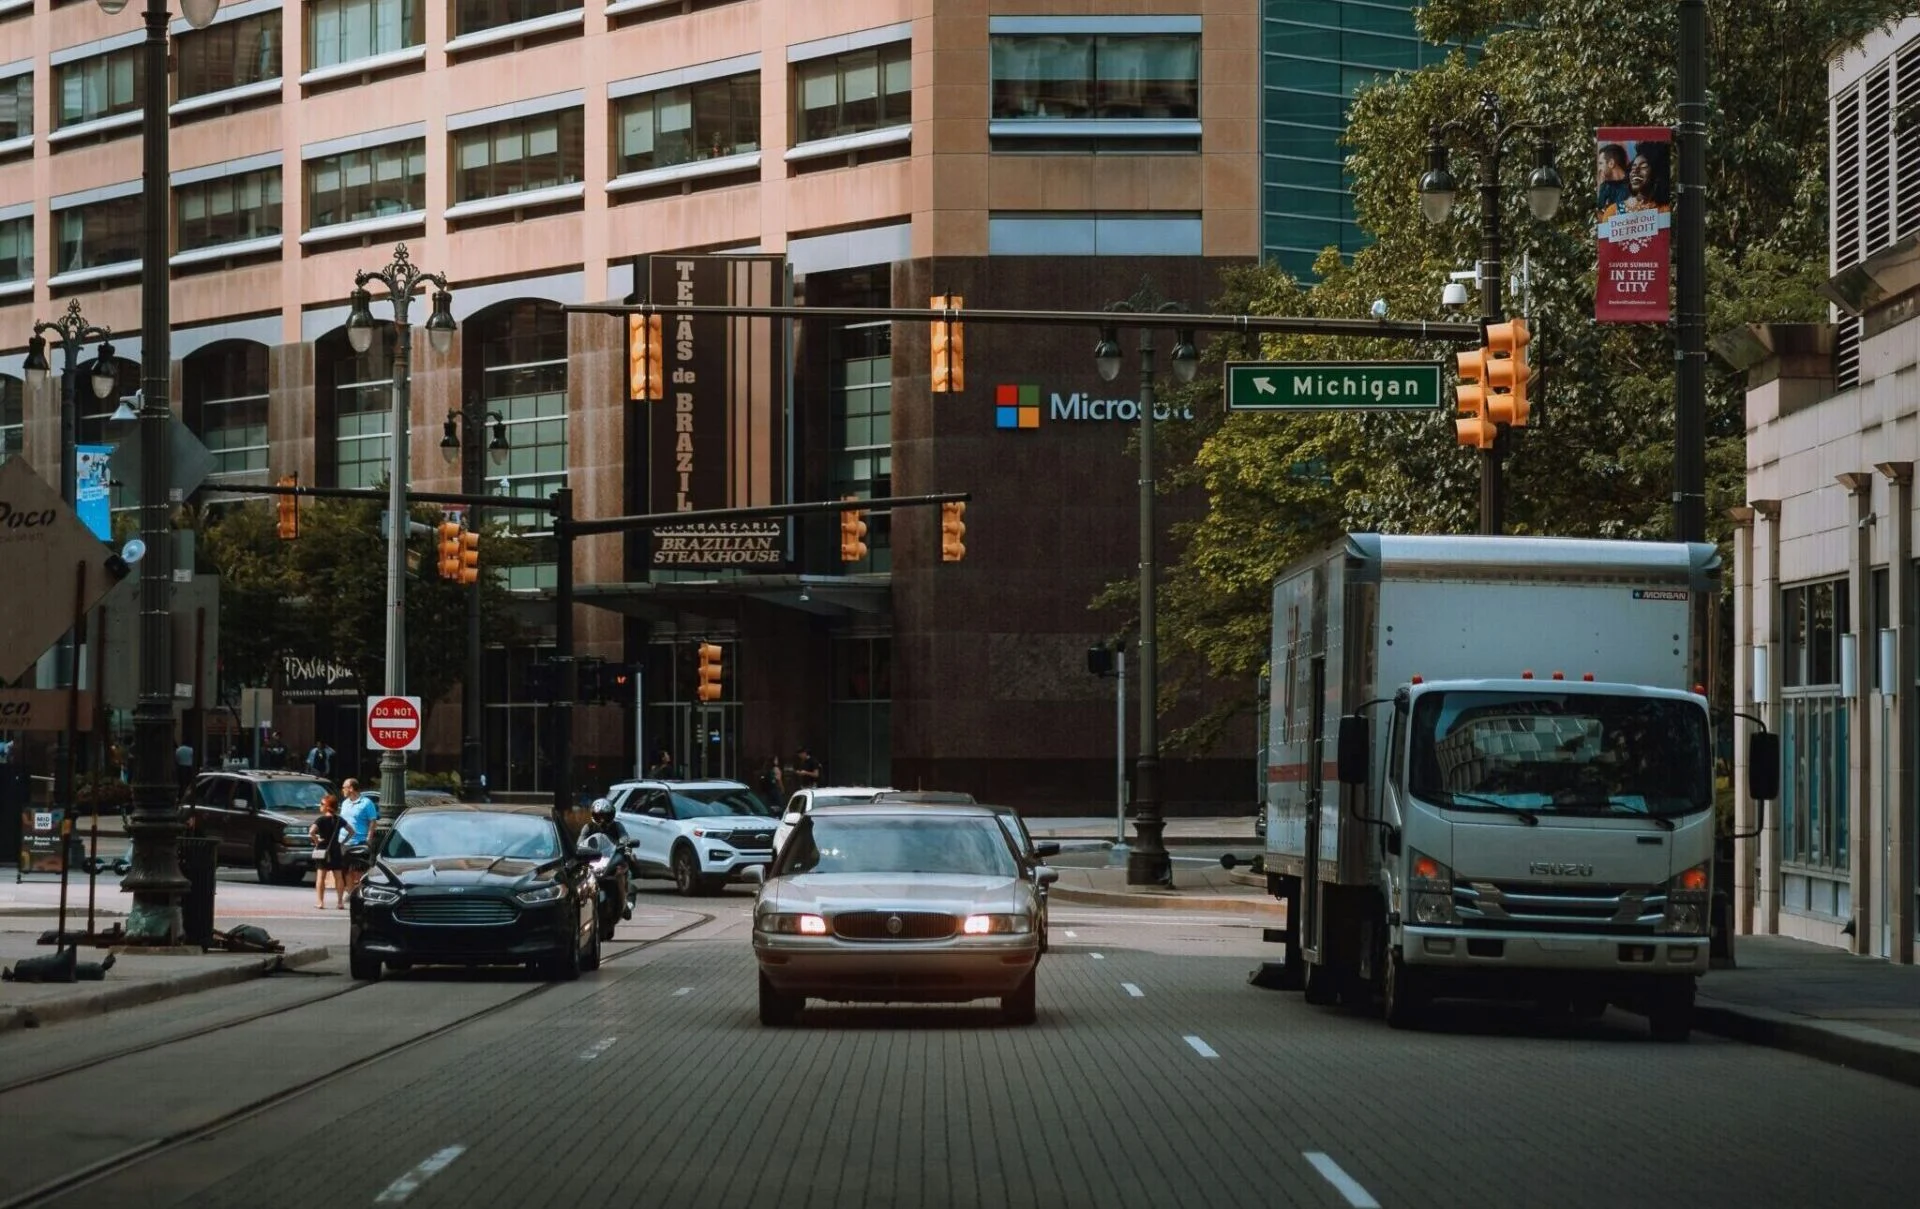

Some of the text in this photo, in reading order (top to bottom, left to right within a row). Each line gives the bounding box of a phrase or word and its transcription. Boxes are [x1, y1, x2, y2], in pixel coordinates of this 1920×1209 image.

[1611, 222, 1656, 237] DETROIT
[1610, 270, 1656, 281] IN THE
[1616, 281, 1649, 293] CITY
[672, 368, 696, 384] de
[1293, 375, 1418, 401] Michigan
[676, 393, 694, 512] BRAZIL
[661, 537, 773, 551] BRAZILIAN
[653, 549, 781, 564] STEAKHOUSE
[1642, 591, 1687, 600] MORGAN
[375, 707, 412, 717] DO NOT
[378, 730, 409, 740] ENTER
[1529, 861, 1594, 877] ISUZU
